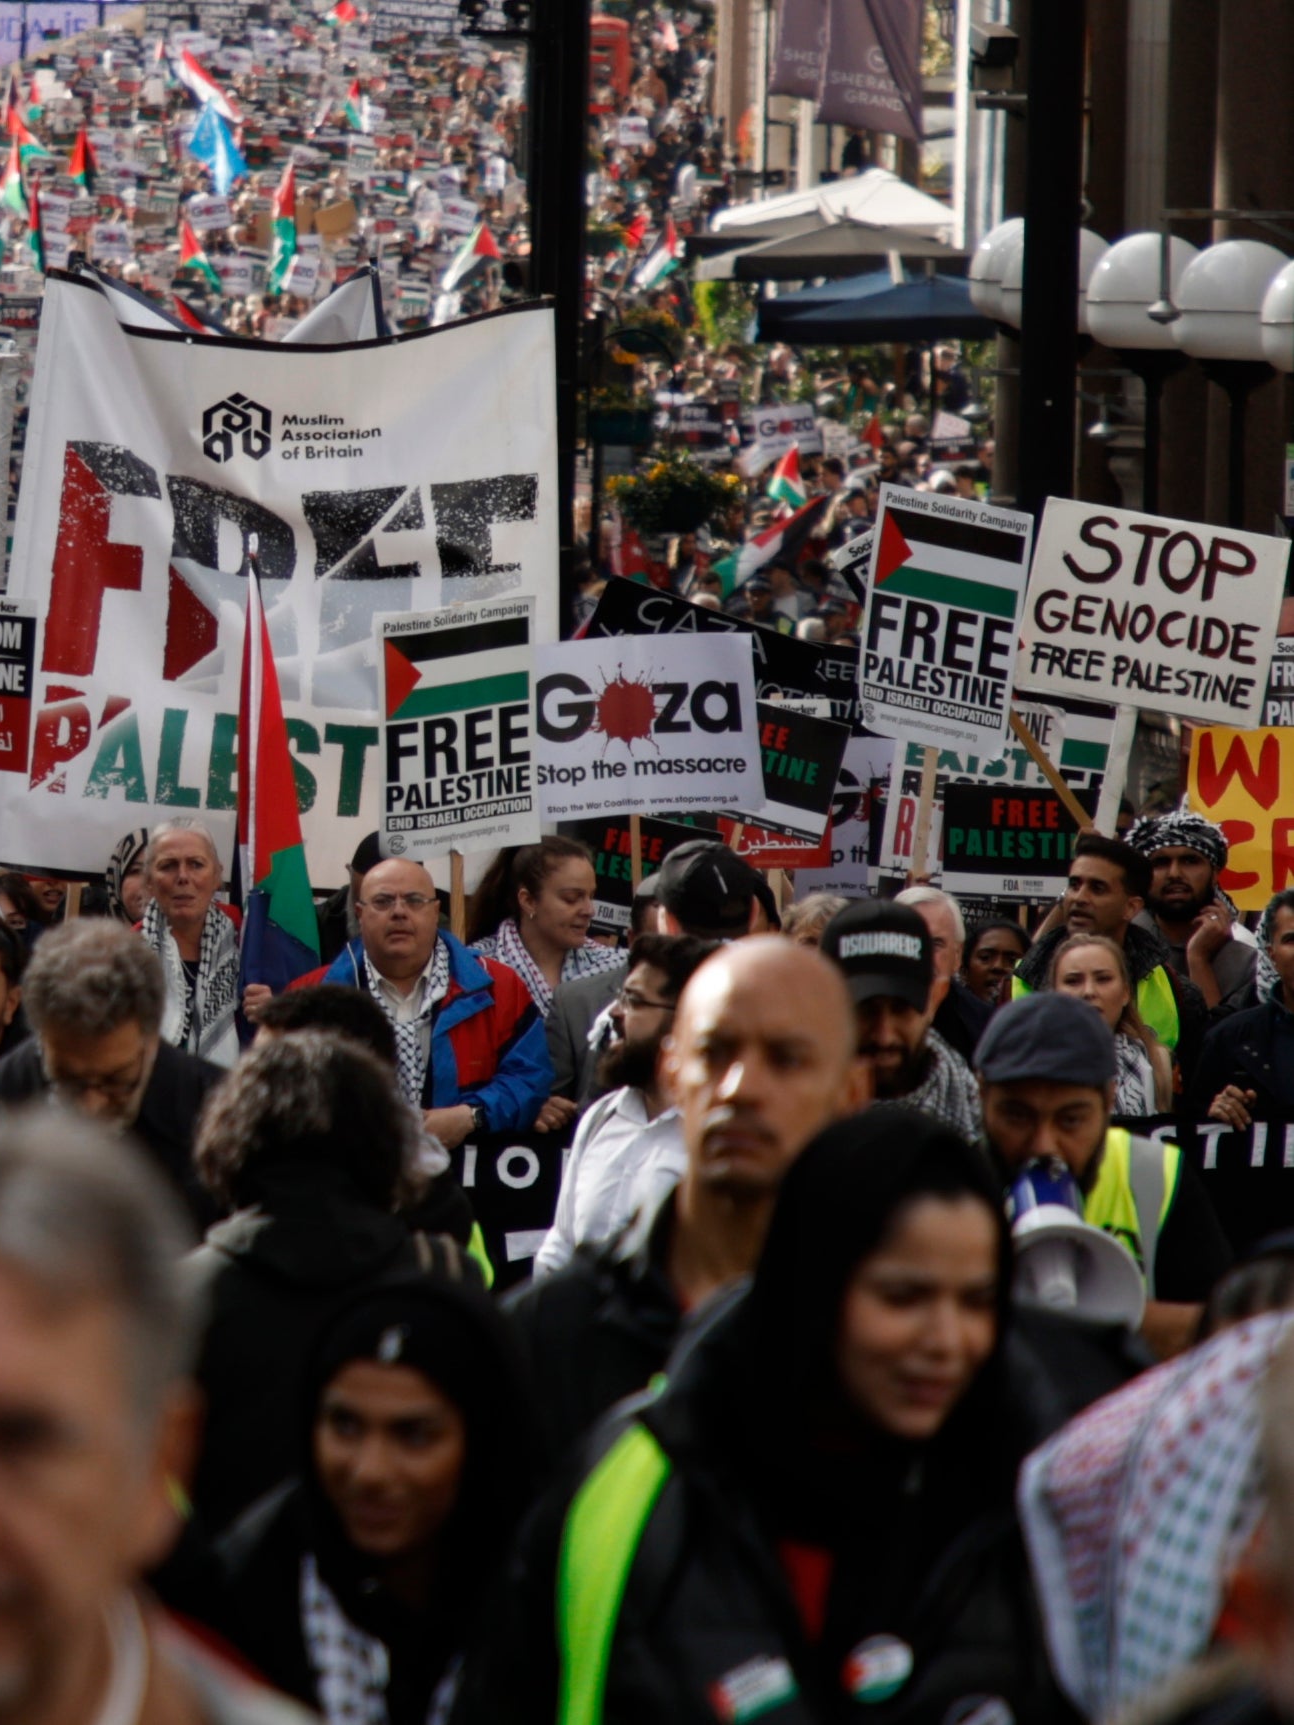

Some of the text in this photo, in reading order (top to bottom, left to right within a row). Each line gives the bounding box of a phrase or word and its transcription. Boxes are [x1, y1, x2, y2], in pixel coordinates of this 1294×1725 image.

[281, 415, 345, 426] Muslim
[281, 427, 382, 442] Association
[281, 445, 364, 460] of Britain
[885, 491, 1028, 533] Palestine Solidarity Campaign
[1062, 515, 1257, 602] STOP
[383, 602, 530, 633] Palestine Solidarity Campaign
[1034, 589, 1261, 666] GENOCIDE
[866, 591, 1015, 682] FREE
[864, 652, 1006, 710] PALESTINE
[1031, 641, 1106, 682] FREE
[1111, 654, 1257, 710] PALESTINE
[864, 683, 884, 700] END
[886, 687, 930, 712] ISRAELI
[932, 700, 1002, 730] OCCUPATION
[386, 703, 531, 784] FREE
[879, 712, 979, 743] www.palestinecampaign.org
[386, 764, 531, 813] PALESTINE
[537, 764, 587, 787] Stop
[592, 760, 627, 781] the
[634, 756, 747, 776] massacre
[387, 796, 531, 832] END ISRAELI OCCUPATION
[547, 794, 740, 815] Stop the War Coalition www.stopwar.org.uk
[990, 797, 1060, 829] FREE
[412, 823, 510, 848] www.palestinecampaign.org
[948, 827, 1076, 860] PALESTI
